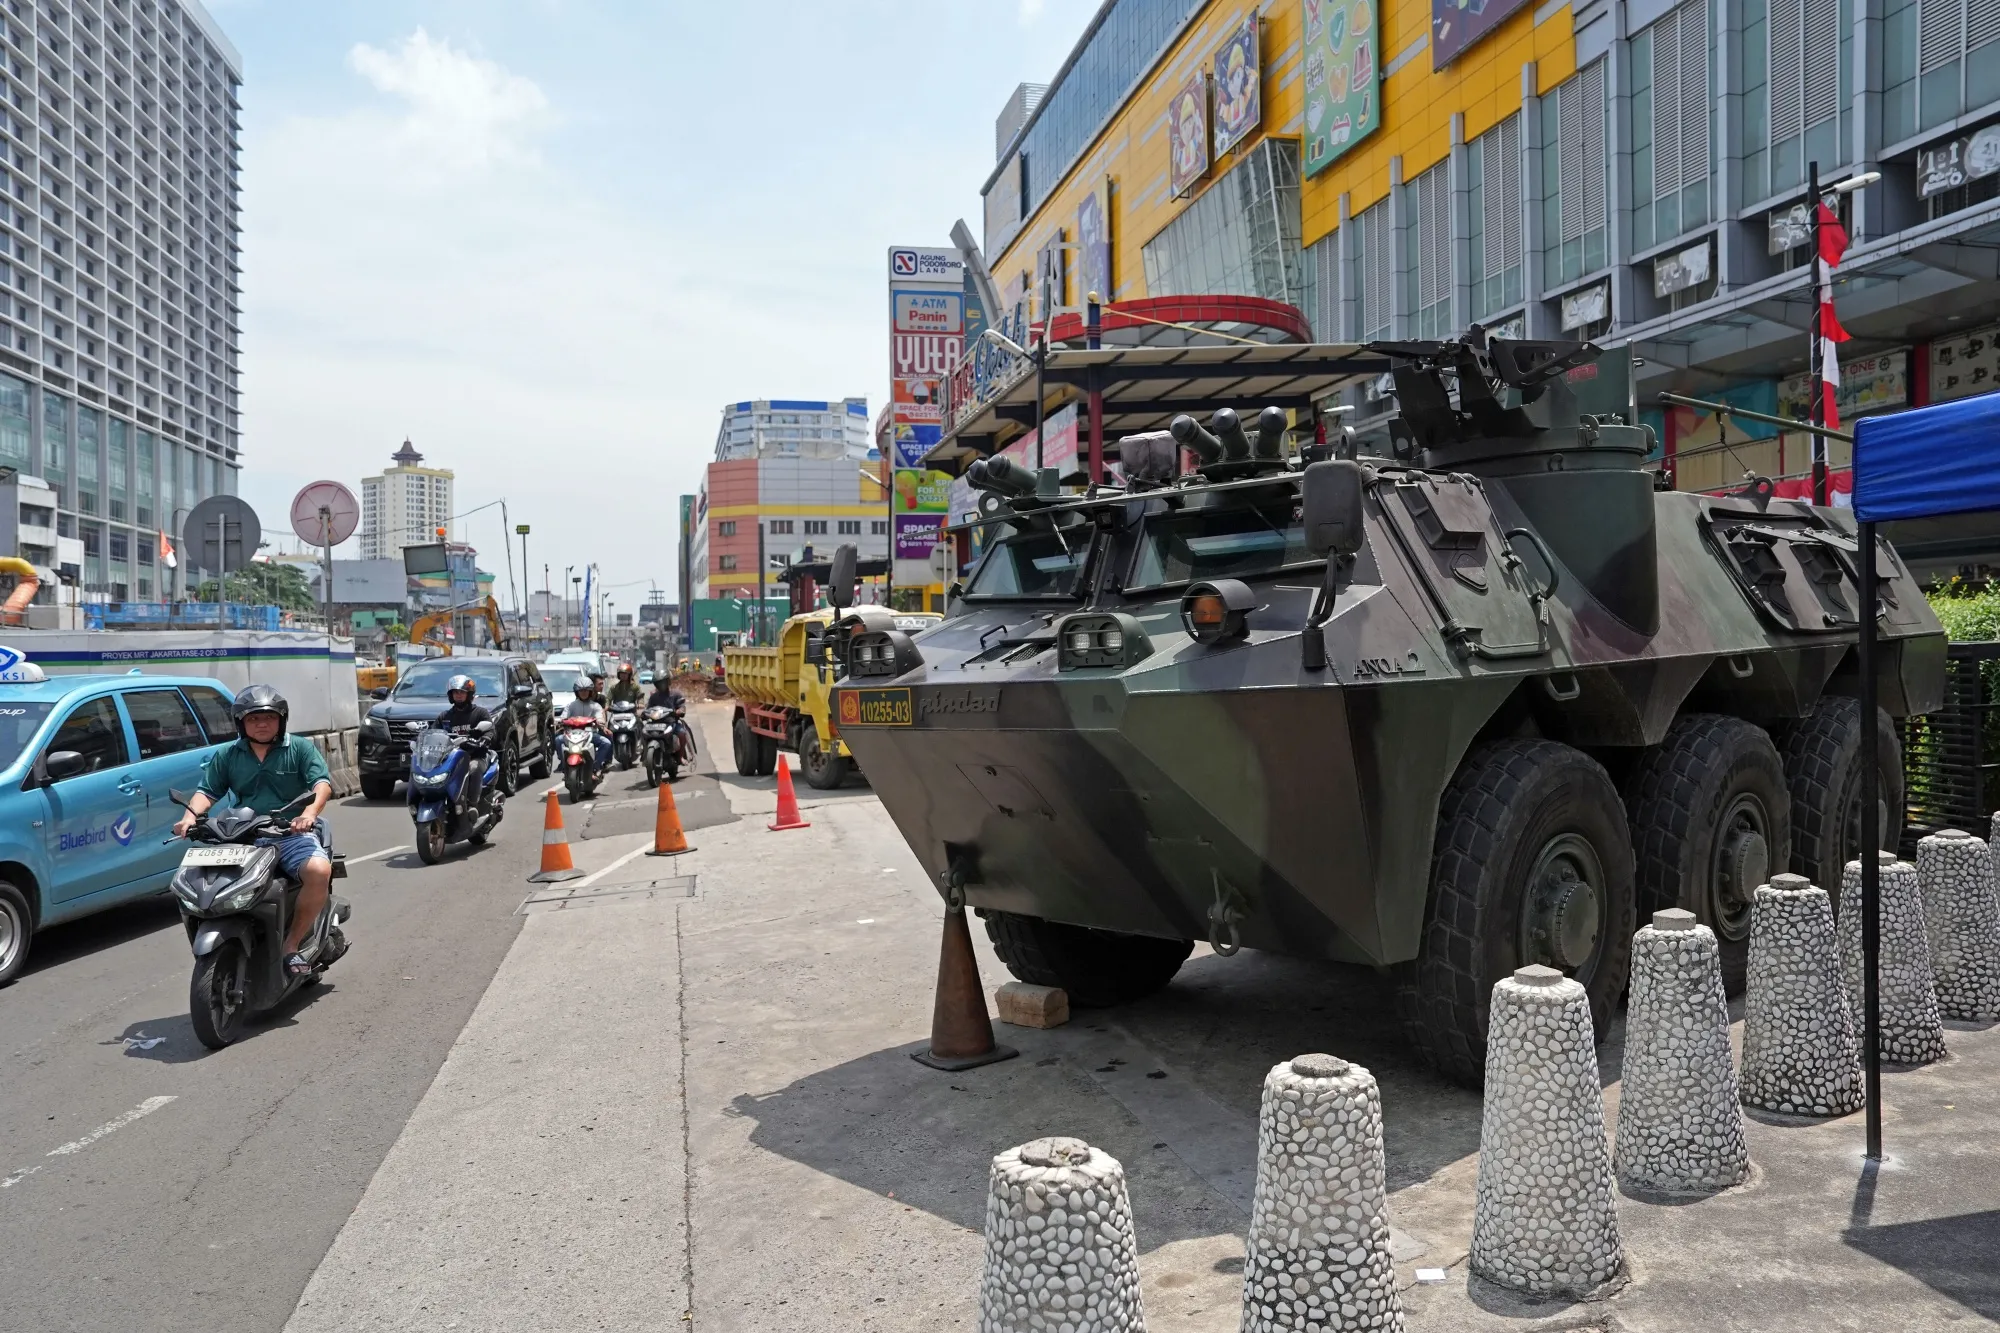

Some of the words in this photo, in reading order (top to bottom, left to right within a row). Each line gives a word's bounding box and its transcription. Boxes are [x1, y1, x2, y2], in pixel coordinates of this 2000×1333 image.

[919, 261, 962, 269] PODOMORO
[921, 298, 947, 309] ATM
[909, 310, 947, 323] Panin
[1850, 360, 1876, 374] ONE
[917, 486, 935, 494] FOR
[903, 524, 938, 534] SPACE
[134, 651, 149, 659] MRT
[150, 650, 181, 658] JAKARTA
[181, 649, 204, 657] FASE-2
[205, 649, 228, 657] CP-203
[1354, 658, 1402, 676] ANOA
[861, 700, 910, 722] 10255-03
[920, 689, 1002, 721] pindad
[60, 825, 106, 852] Bluebird
[187, 849, 194, 858] B
